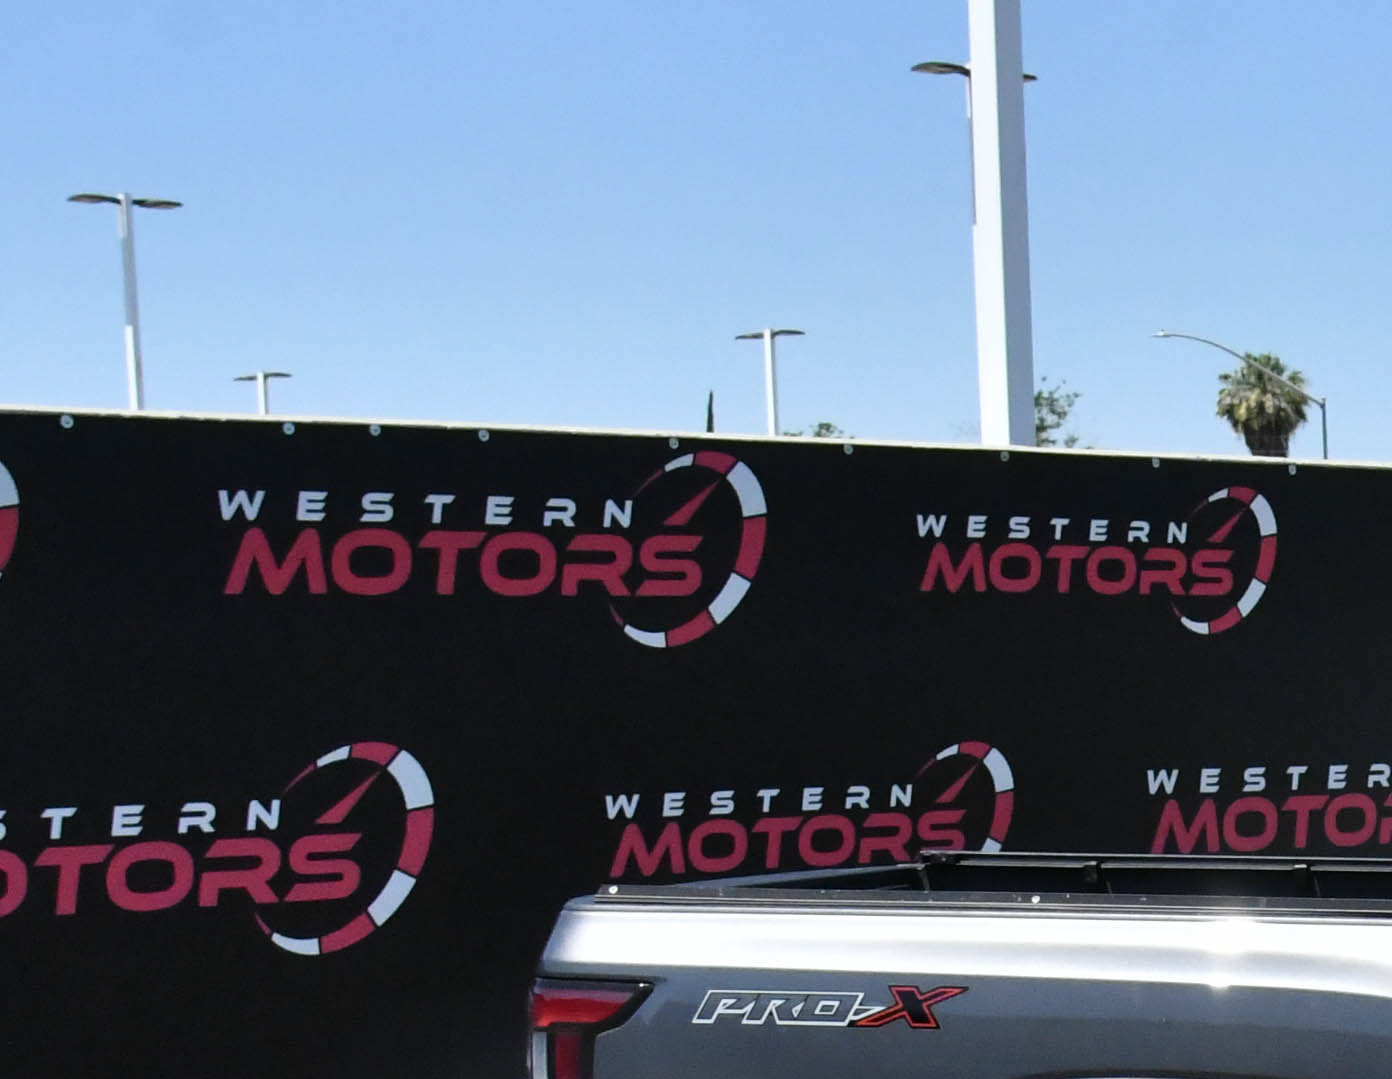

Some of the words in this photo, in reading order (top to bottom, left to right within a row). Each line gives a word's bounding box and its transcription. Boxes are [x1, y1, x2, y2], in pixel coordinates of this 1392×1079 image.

[218, 489, 633, 528] WESTERN
[916, 514, 1188, 544] WESTERN
[224, 527, 703, 597] MOTORS
[920, 542, 1234, 596] MOTORS
[0, 799, 281, 841] TERN
[605, 784, 913, 820] WESTERN
[609, 809, 965, 878] MOTORS
